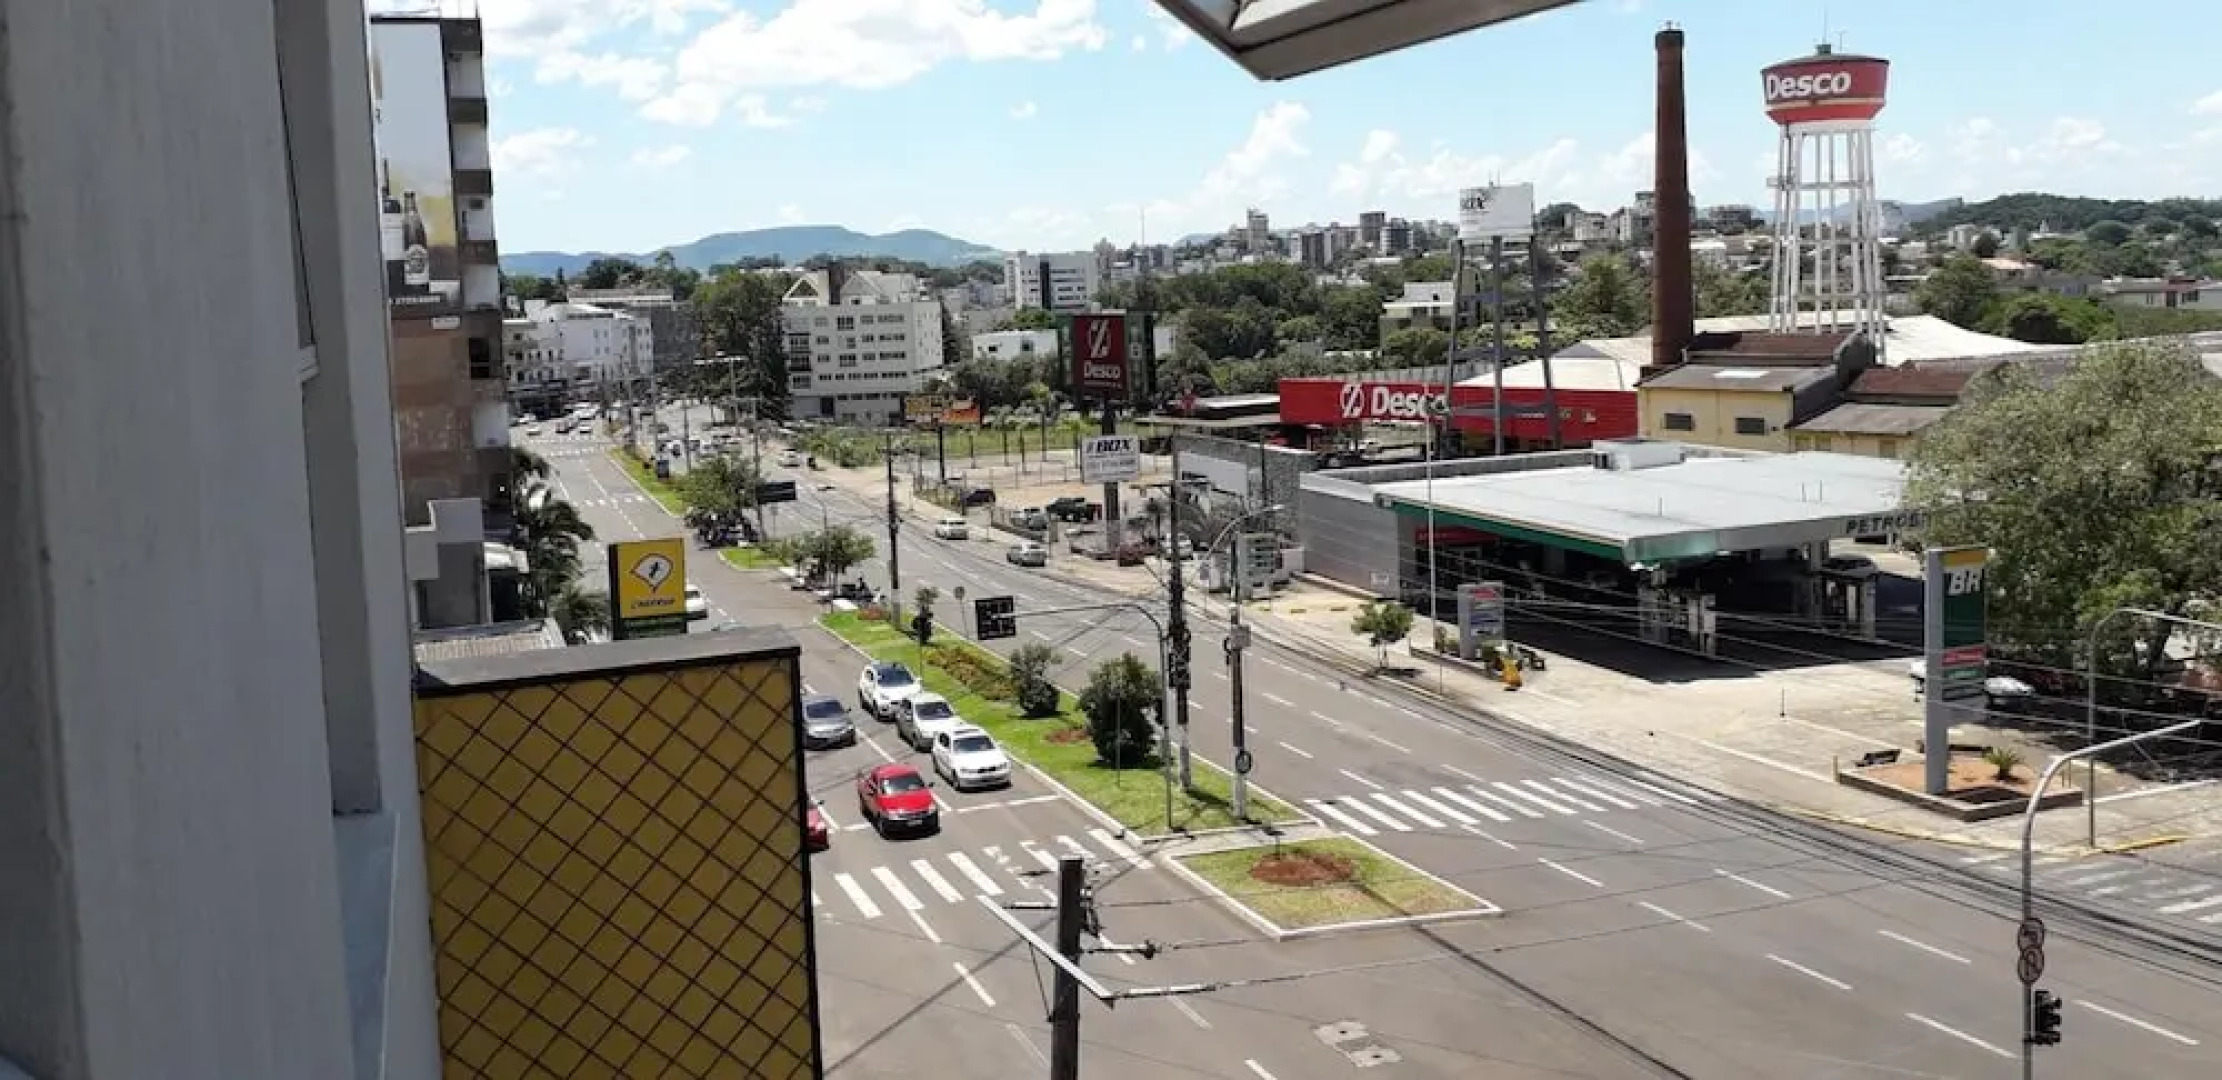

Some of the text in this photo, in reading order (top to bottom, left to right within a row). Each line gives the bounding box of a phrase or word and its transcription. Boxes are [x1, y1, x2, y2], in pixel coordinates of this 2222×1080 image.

[1766, 72, 1851, 99] Desco
[1083, 361, 1121, 379] Desco
[1949, 569, 1981, 595] BR
